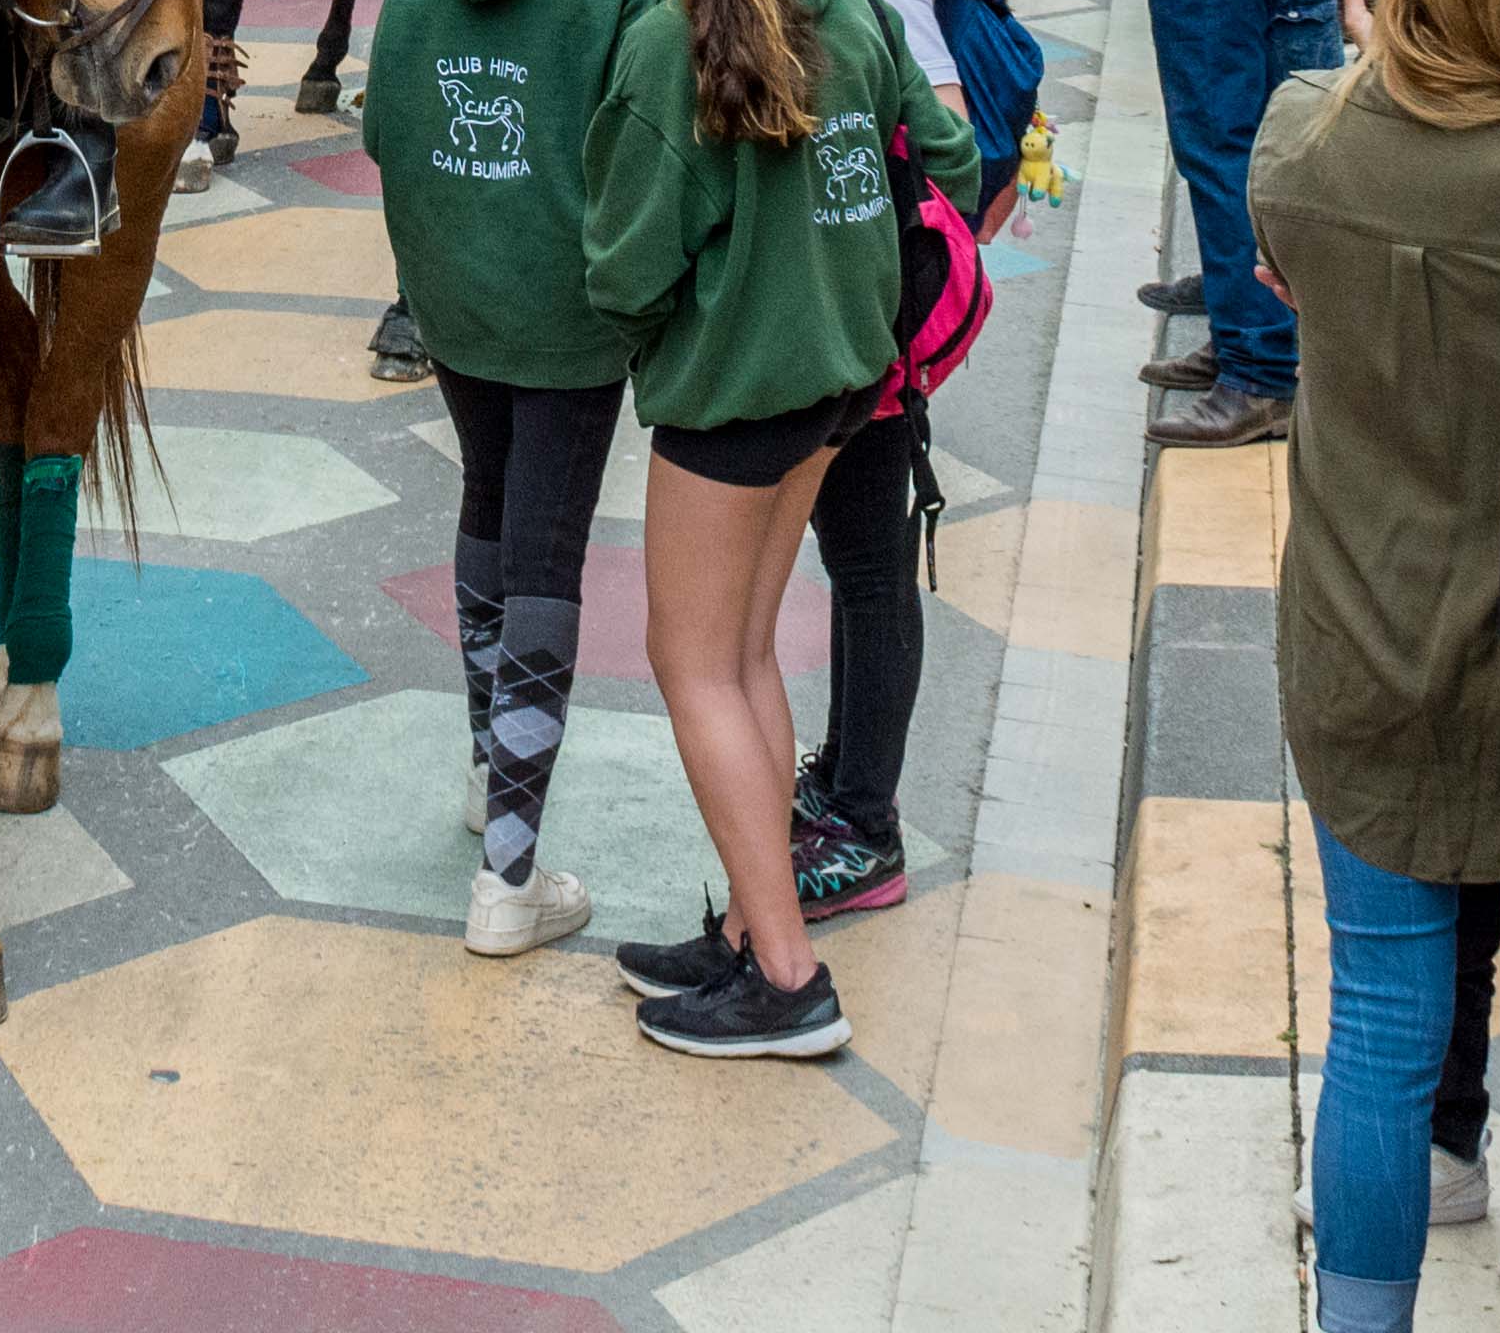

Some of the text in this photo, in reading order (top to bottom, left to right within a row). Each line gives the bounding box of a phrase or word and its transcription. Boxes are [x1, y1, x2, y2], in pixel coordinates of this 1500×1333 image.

[436, 56, 528, 84] CLUB HIPIC
[840, 112, 876, 131] HIPIC
[432, 149, 532, 180] CAN BUIMIRA
[813, 207, 842, 226] CAN
